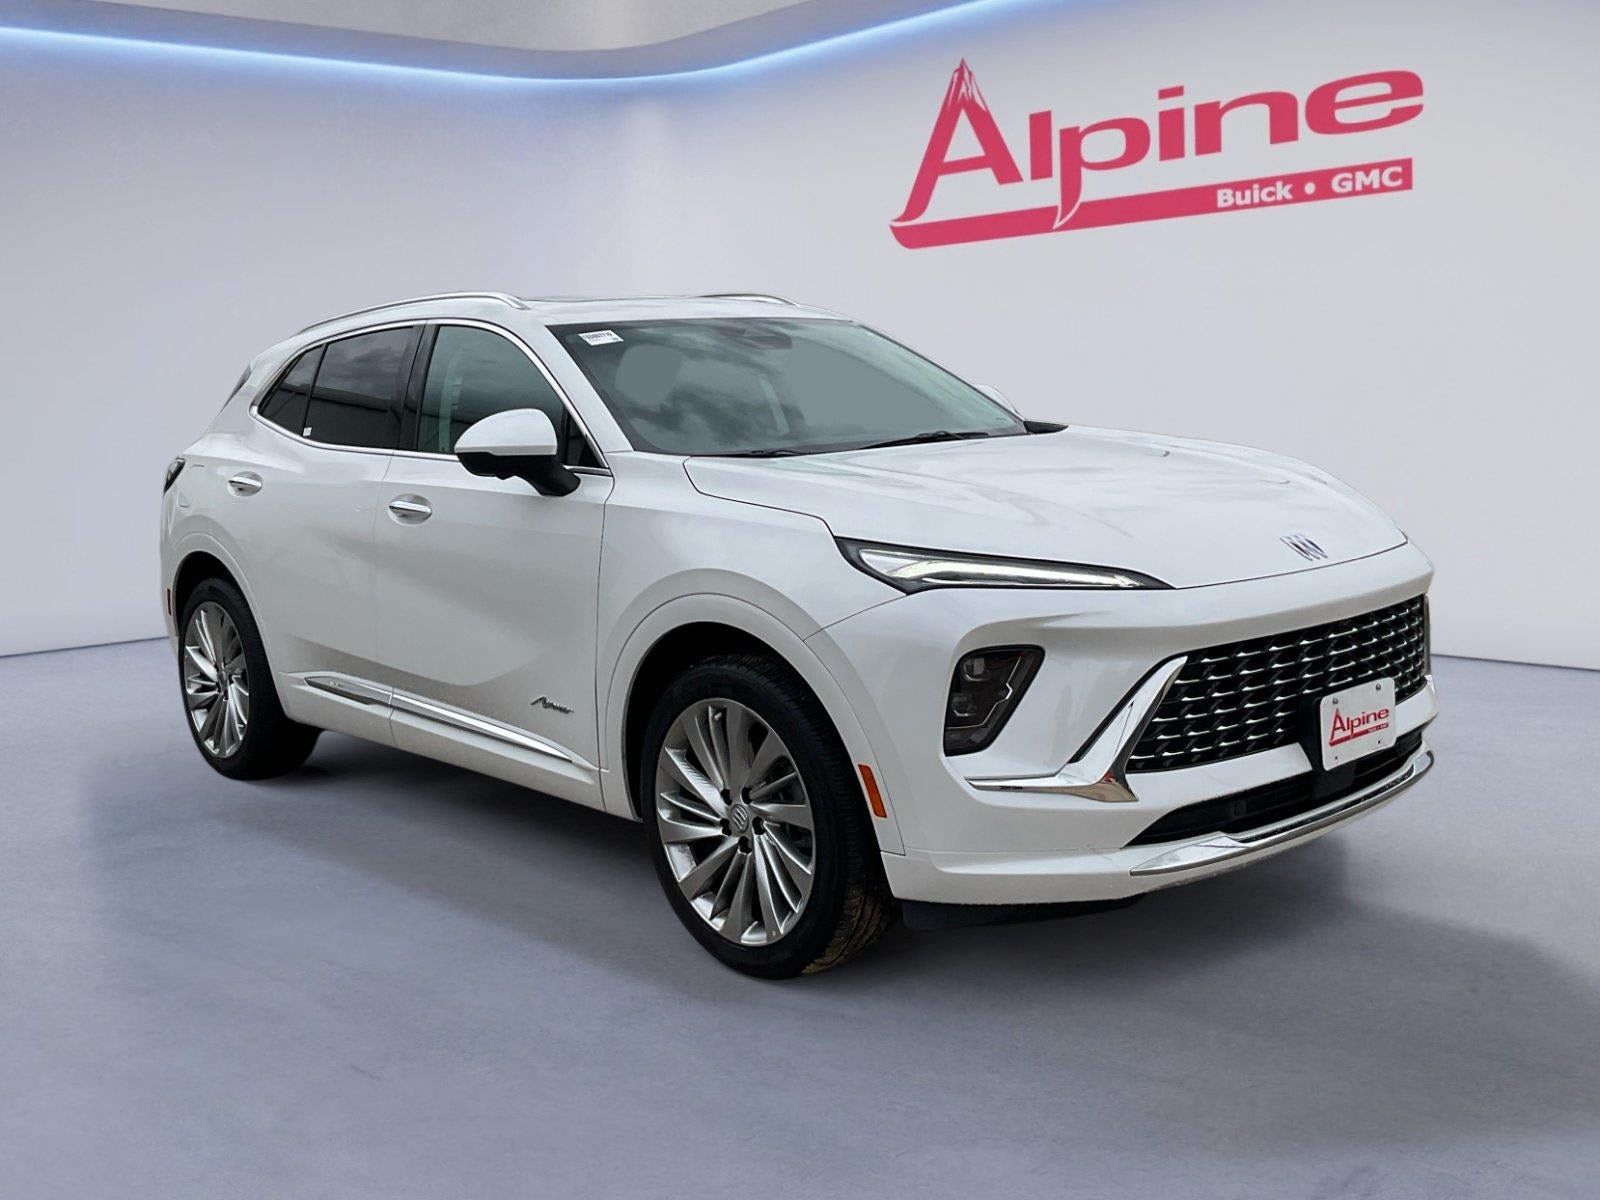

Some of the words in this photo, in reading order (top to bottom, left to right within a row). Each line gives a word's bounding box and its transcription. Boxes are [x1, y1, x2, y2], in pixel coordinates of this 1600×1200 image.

[890, 58, 1424, 229] Alpine
[1216, 180, 1293, 208] Buick
[1331, 165, 1404, 194] GMC
[1330, 708, 1389, 741] Alpine
